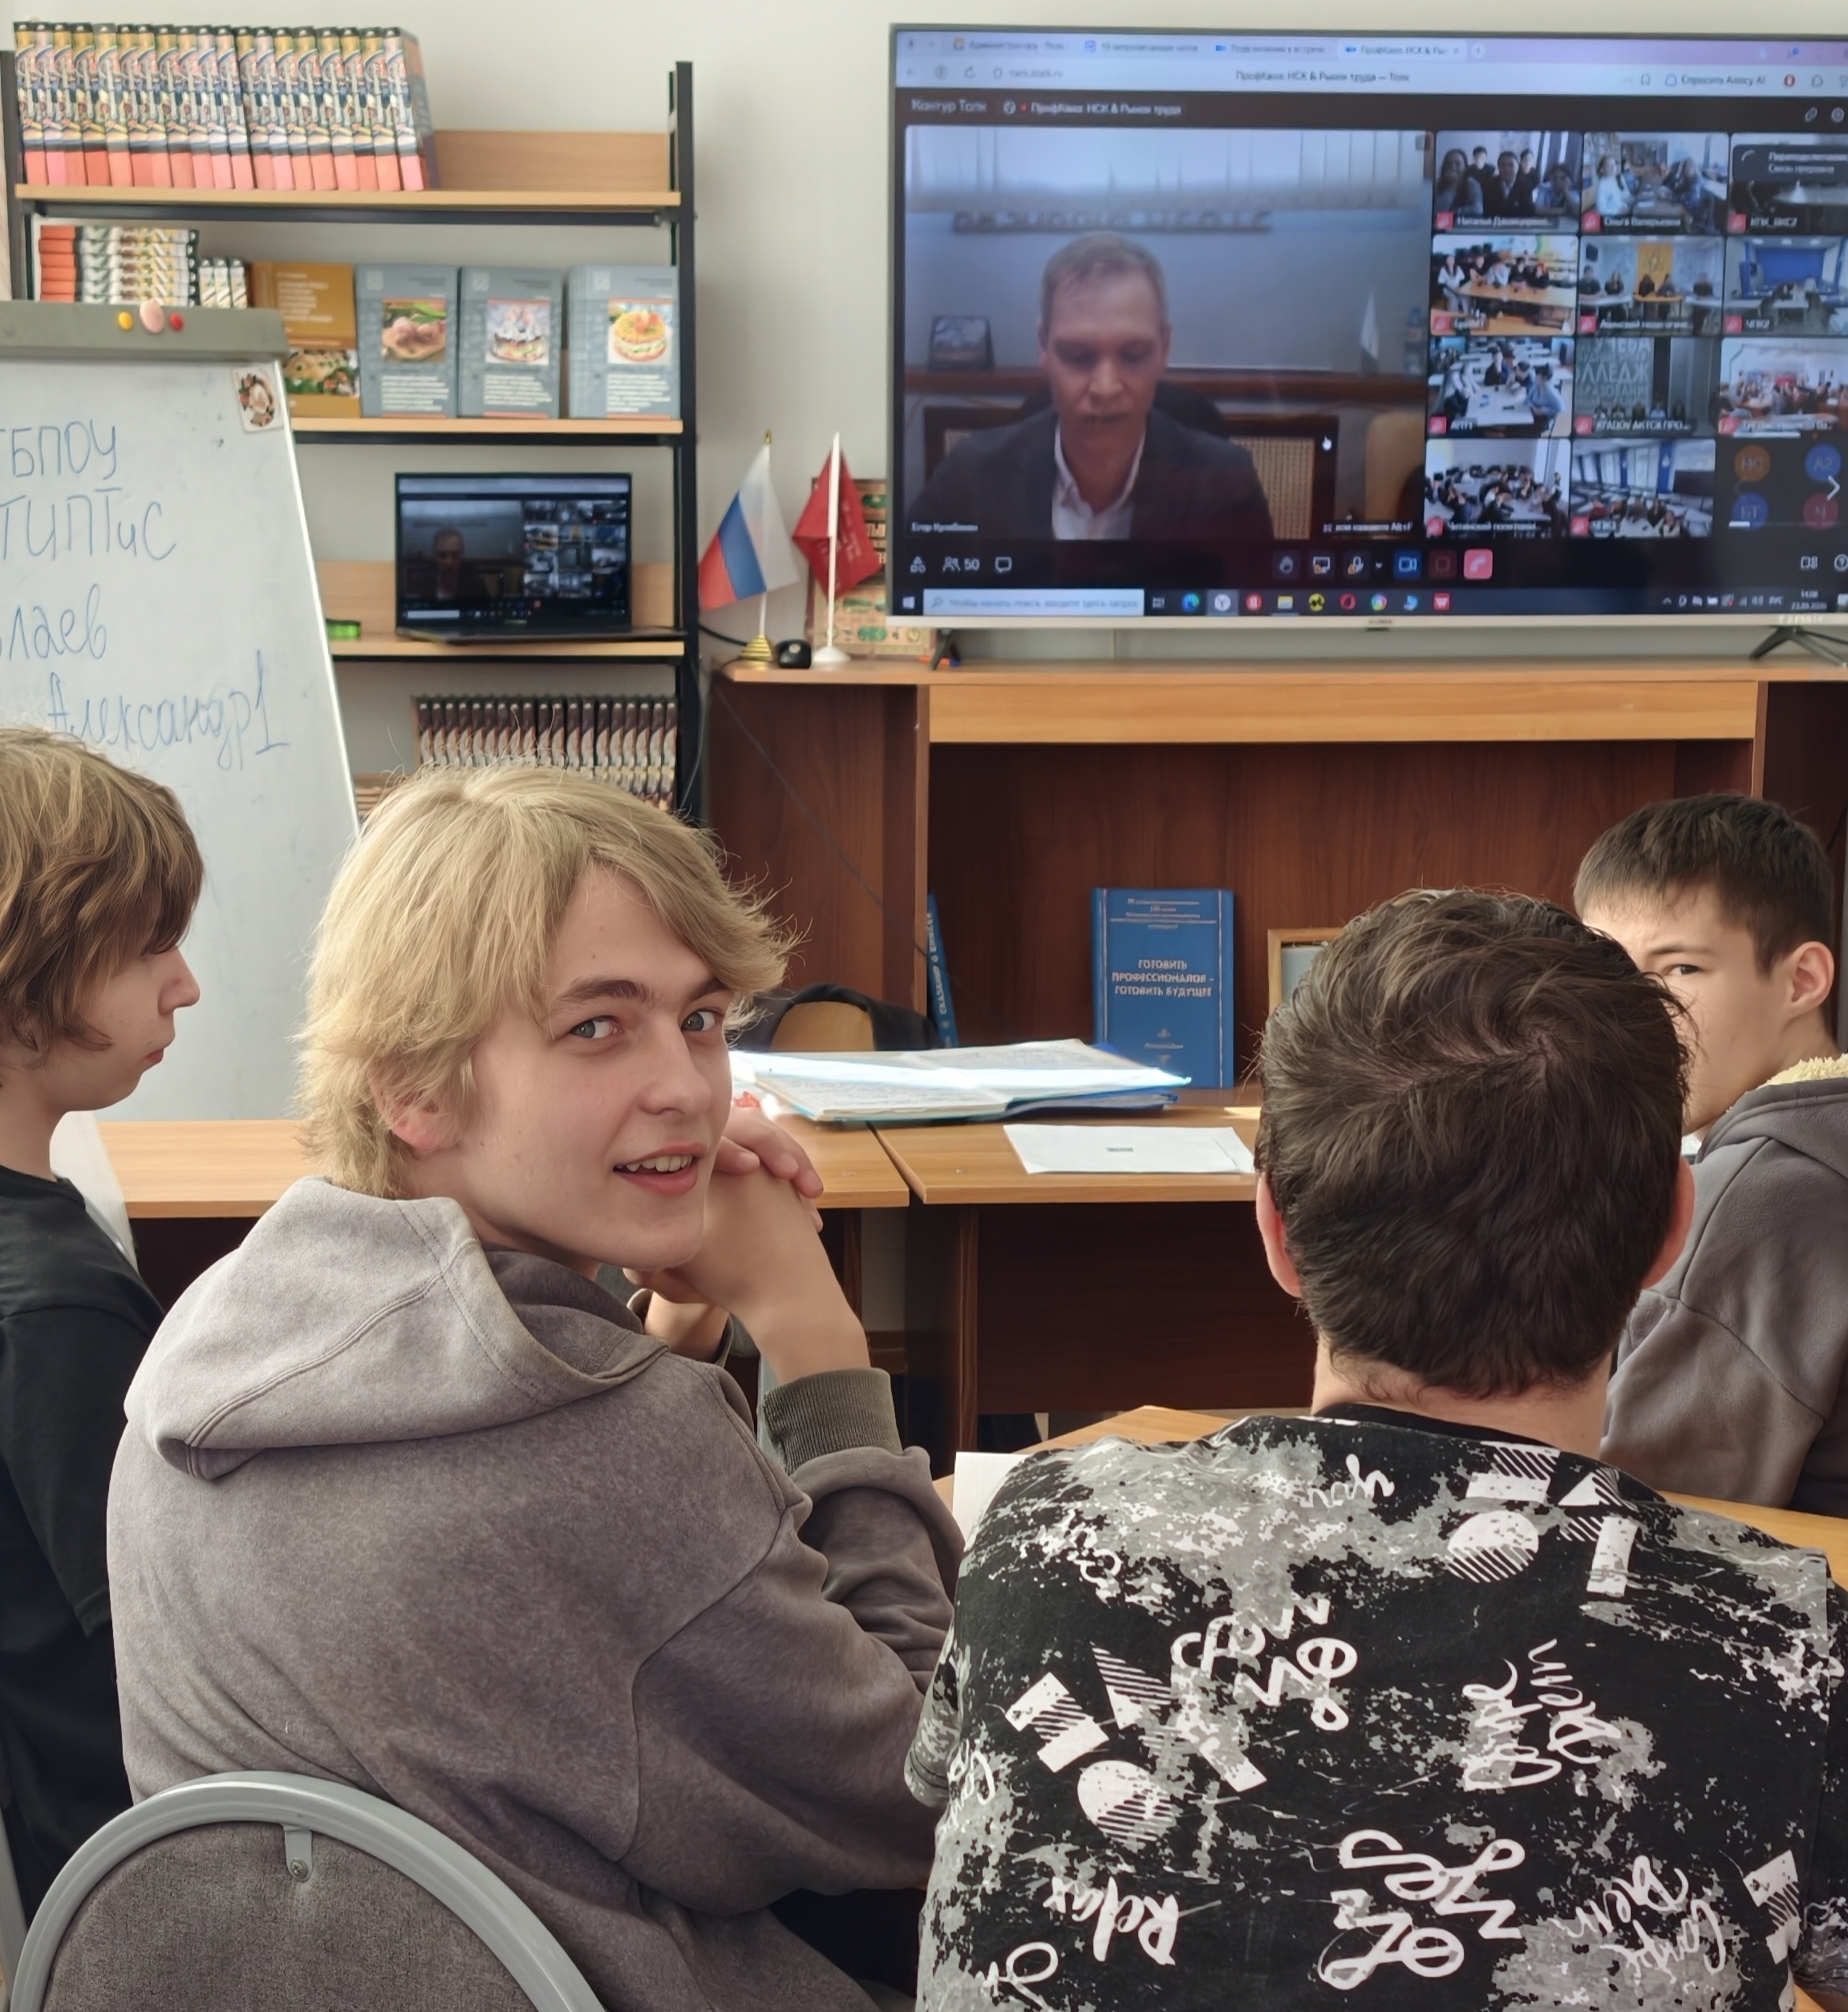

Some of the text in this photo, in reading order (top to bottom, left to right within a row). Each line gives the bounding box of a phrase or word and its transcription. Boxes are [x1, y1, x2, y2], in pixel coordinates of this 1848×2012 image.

[911, 99, 987, 114] Контур Толк
[0, 420, 117, 481] БПОУ
[964, 558, 980, 571] 50
[0, 582, 107, 661] лаев
[1138, 959, 1187, 971] ГОТОВИТЬ
[1112, 972, 1206, 984] ПРОФЕССИОНАЛОВ
[1114, 985, 1164, 996] ГОТОВИТЬ
[1043, 1876, 1179, 1966] Relax
